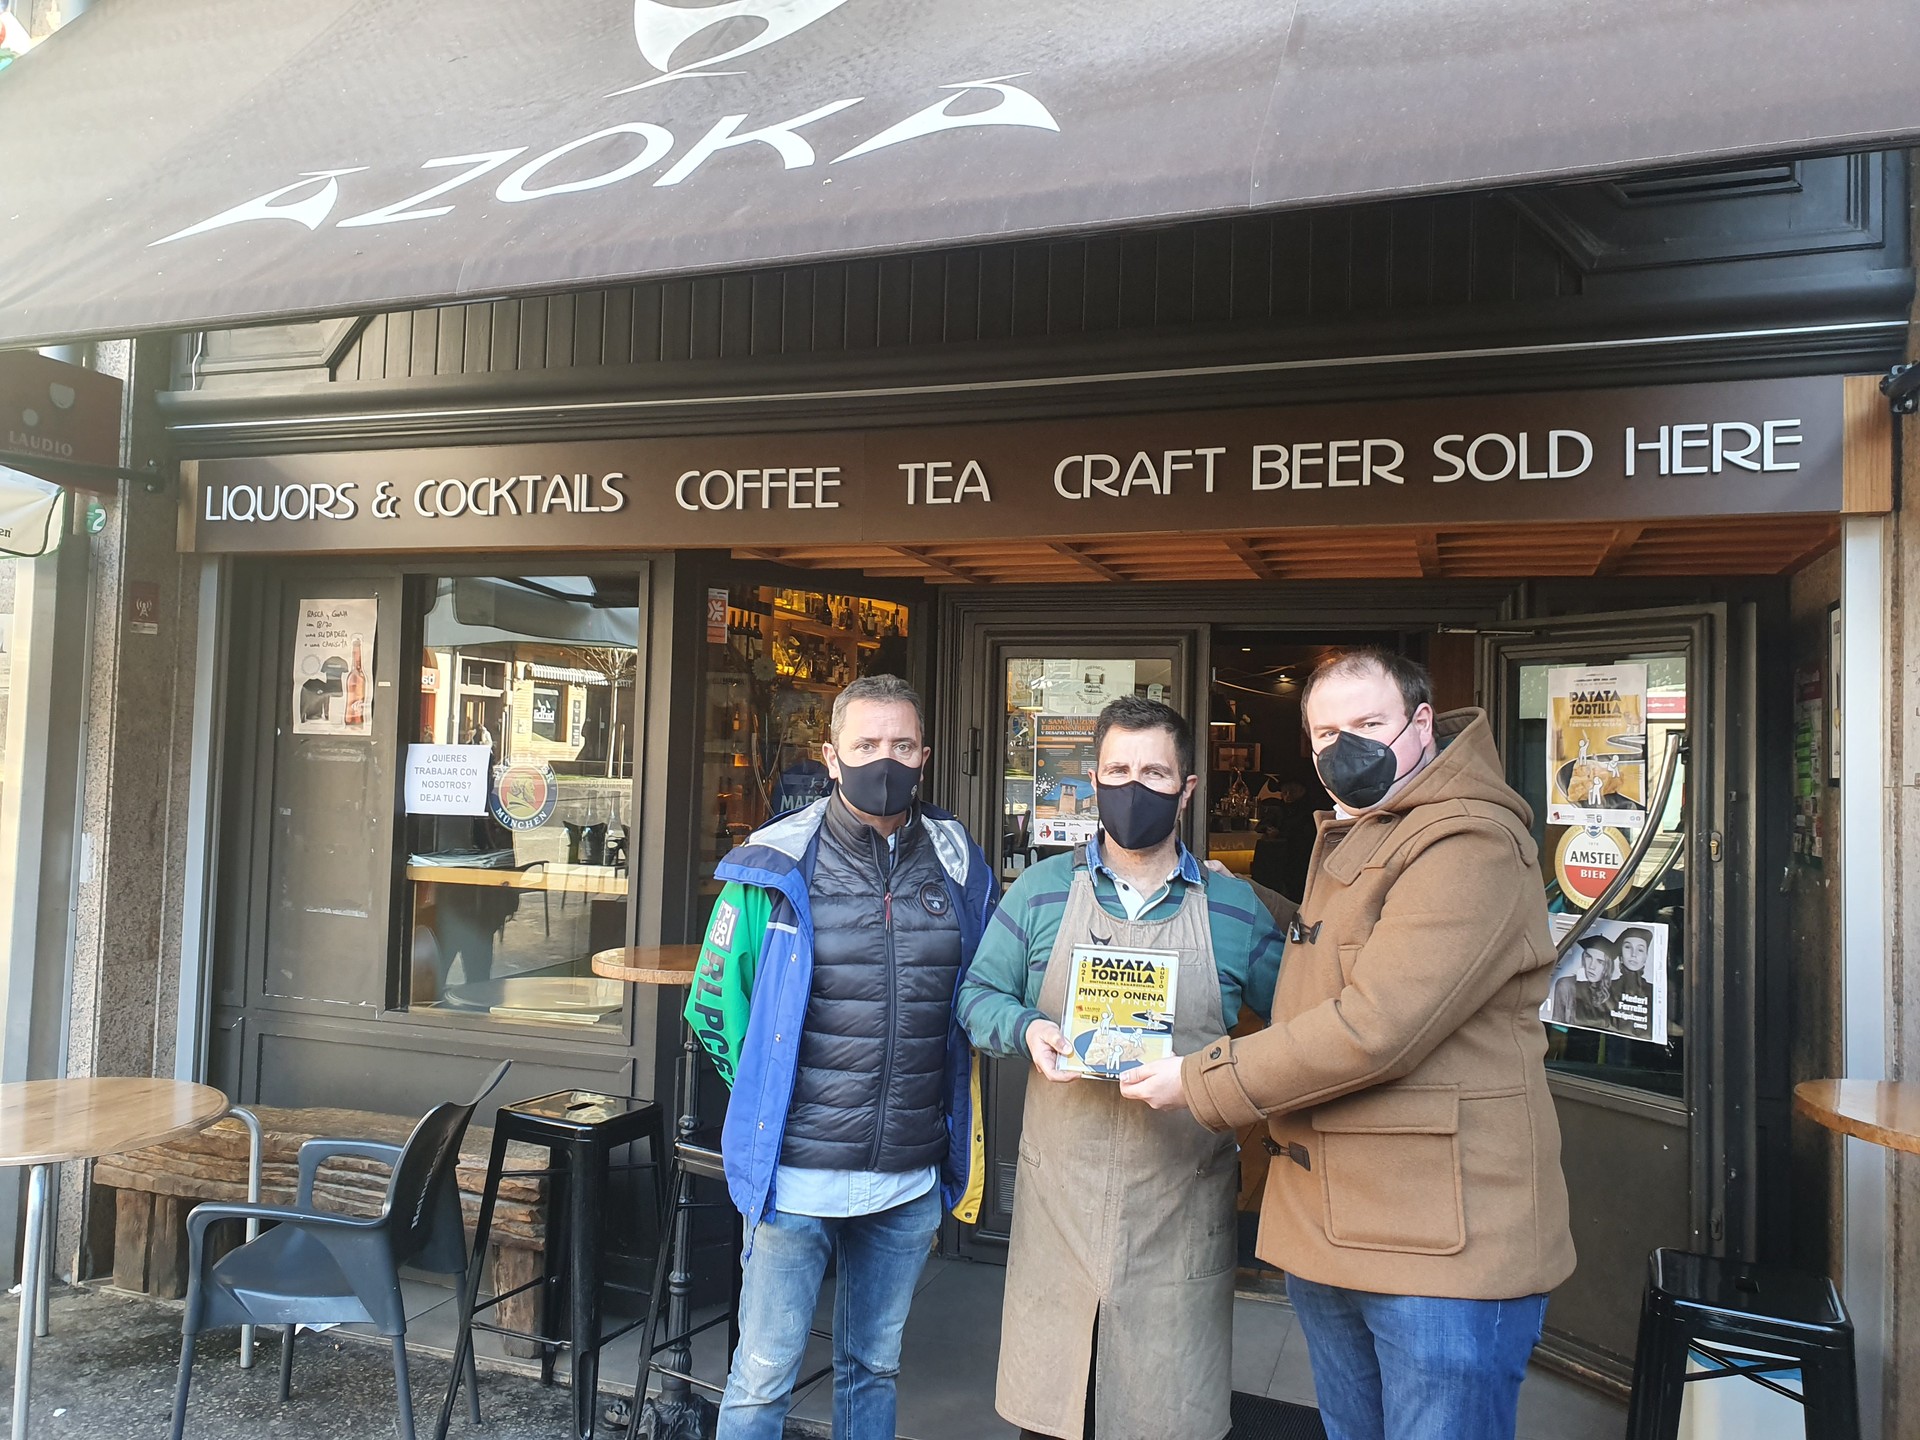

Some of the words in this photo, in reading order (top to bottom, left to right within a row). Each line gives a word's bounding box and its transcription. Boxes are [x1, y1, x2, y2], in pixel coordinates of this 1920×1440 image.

[9, 430, 73, 457] LAUDIO
[1053, 447, 1226, 499] CRAFT
[1251, 438, 1405, 491] BEER
[1432, 429, 1594, 484] SOLD
[1625, 419, 1803, 477] HERE
[675, 466, 841, 511] COFFEE
[898, 460, 991, 504] TEA
[205, 482, 356, 522] LIQUORS
[371, 481, 399, 518] &
[413, 472, 625, 518] COCKTAILS
[1569, 689, 1622, 702] PATATA
[1569, 702, 1622, 715] TORTILLA
[426, 754, 467, 763] ¿QUIERES
[414, 766, 458, 776] TRABAJAR
[459, 767, 478, 776] CON
[421, 780, 472, 790] NOSOTROS?
[419, 793, 441, 802] DEJA
[443, 794, 453, 803] TU
[780, 794, 823, 812] MA
[1569, 850, 1619, 866] AMSTEL
[1580, 869, 1607, 880] BIER
[1091, 957, 1156, 973] PATATA
[1091, 968, 1156, 984] TORTILLA
[1078, 987, 1120, 998] PINTXO
[1123, 991, 1165, 1002] ONENA
